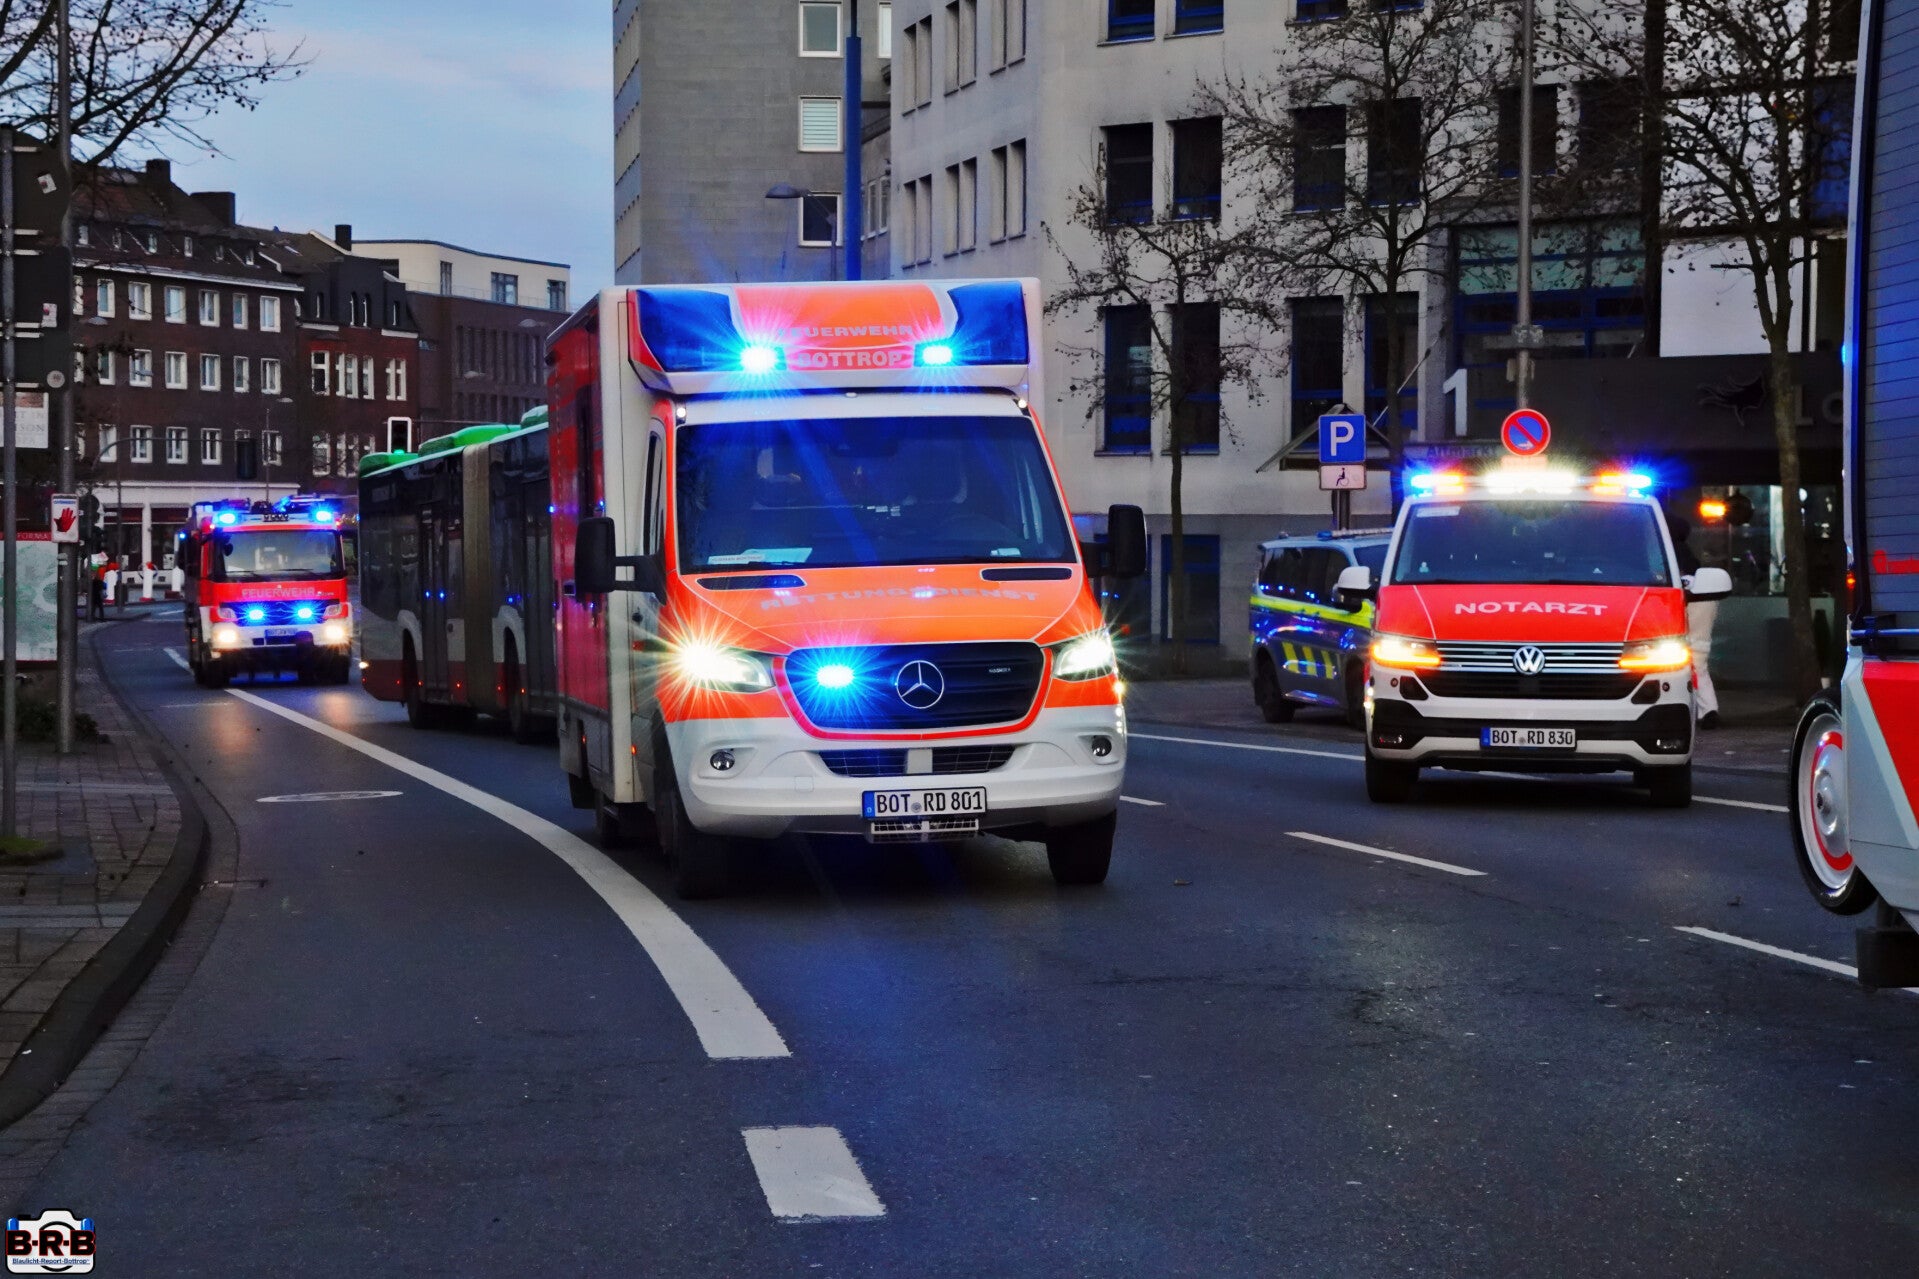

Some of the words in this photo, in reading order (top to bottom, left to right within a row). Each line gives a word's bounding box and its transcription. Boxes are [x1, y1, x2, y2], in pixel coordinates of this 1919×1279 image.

[777, 325, 913, 337] FEUERWEHR
[797, 351, 902, 368] BOTTROP
[1330, 421, 1355, 456] P
[242, 587, 315, 598] FEUERWEHR
[1455, 602, 1608, 616] NOTARZT
[1492, 730, 1517, 744] BOT
[1527, 730, 1545, 745] RD
[1548, 731, 1573, 745] 830
[877, 794, 910, 813] BOT
[923, 793, 946, 812] RD
[951, 791, 983, 810] 801
